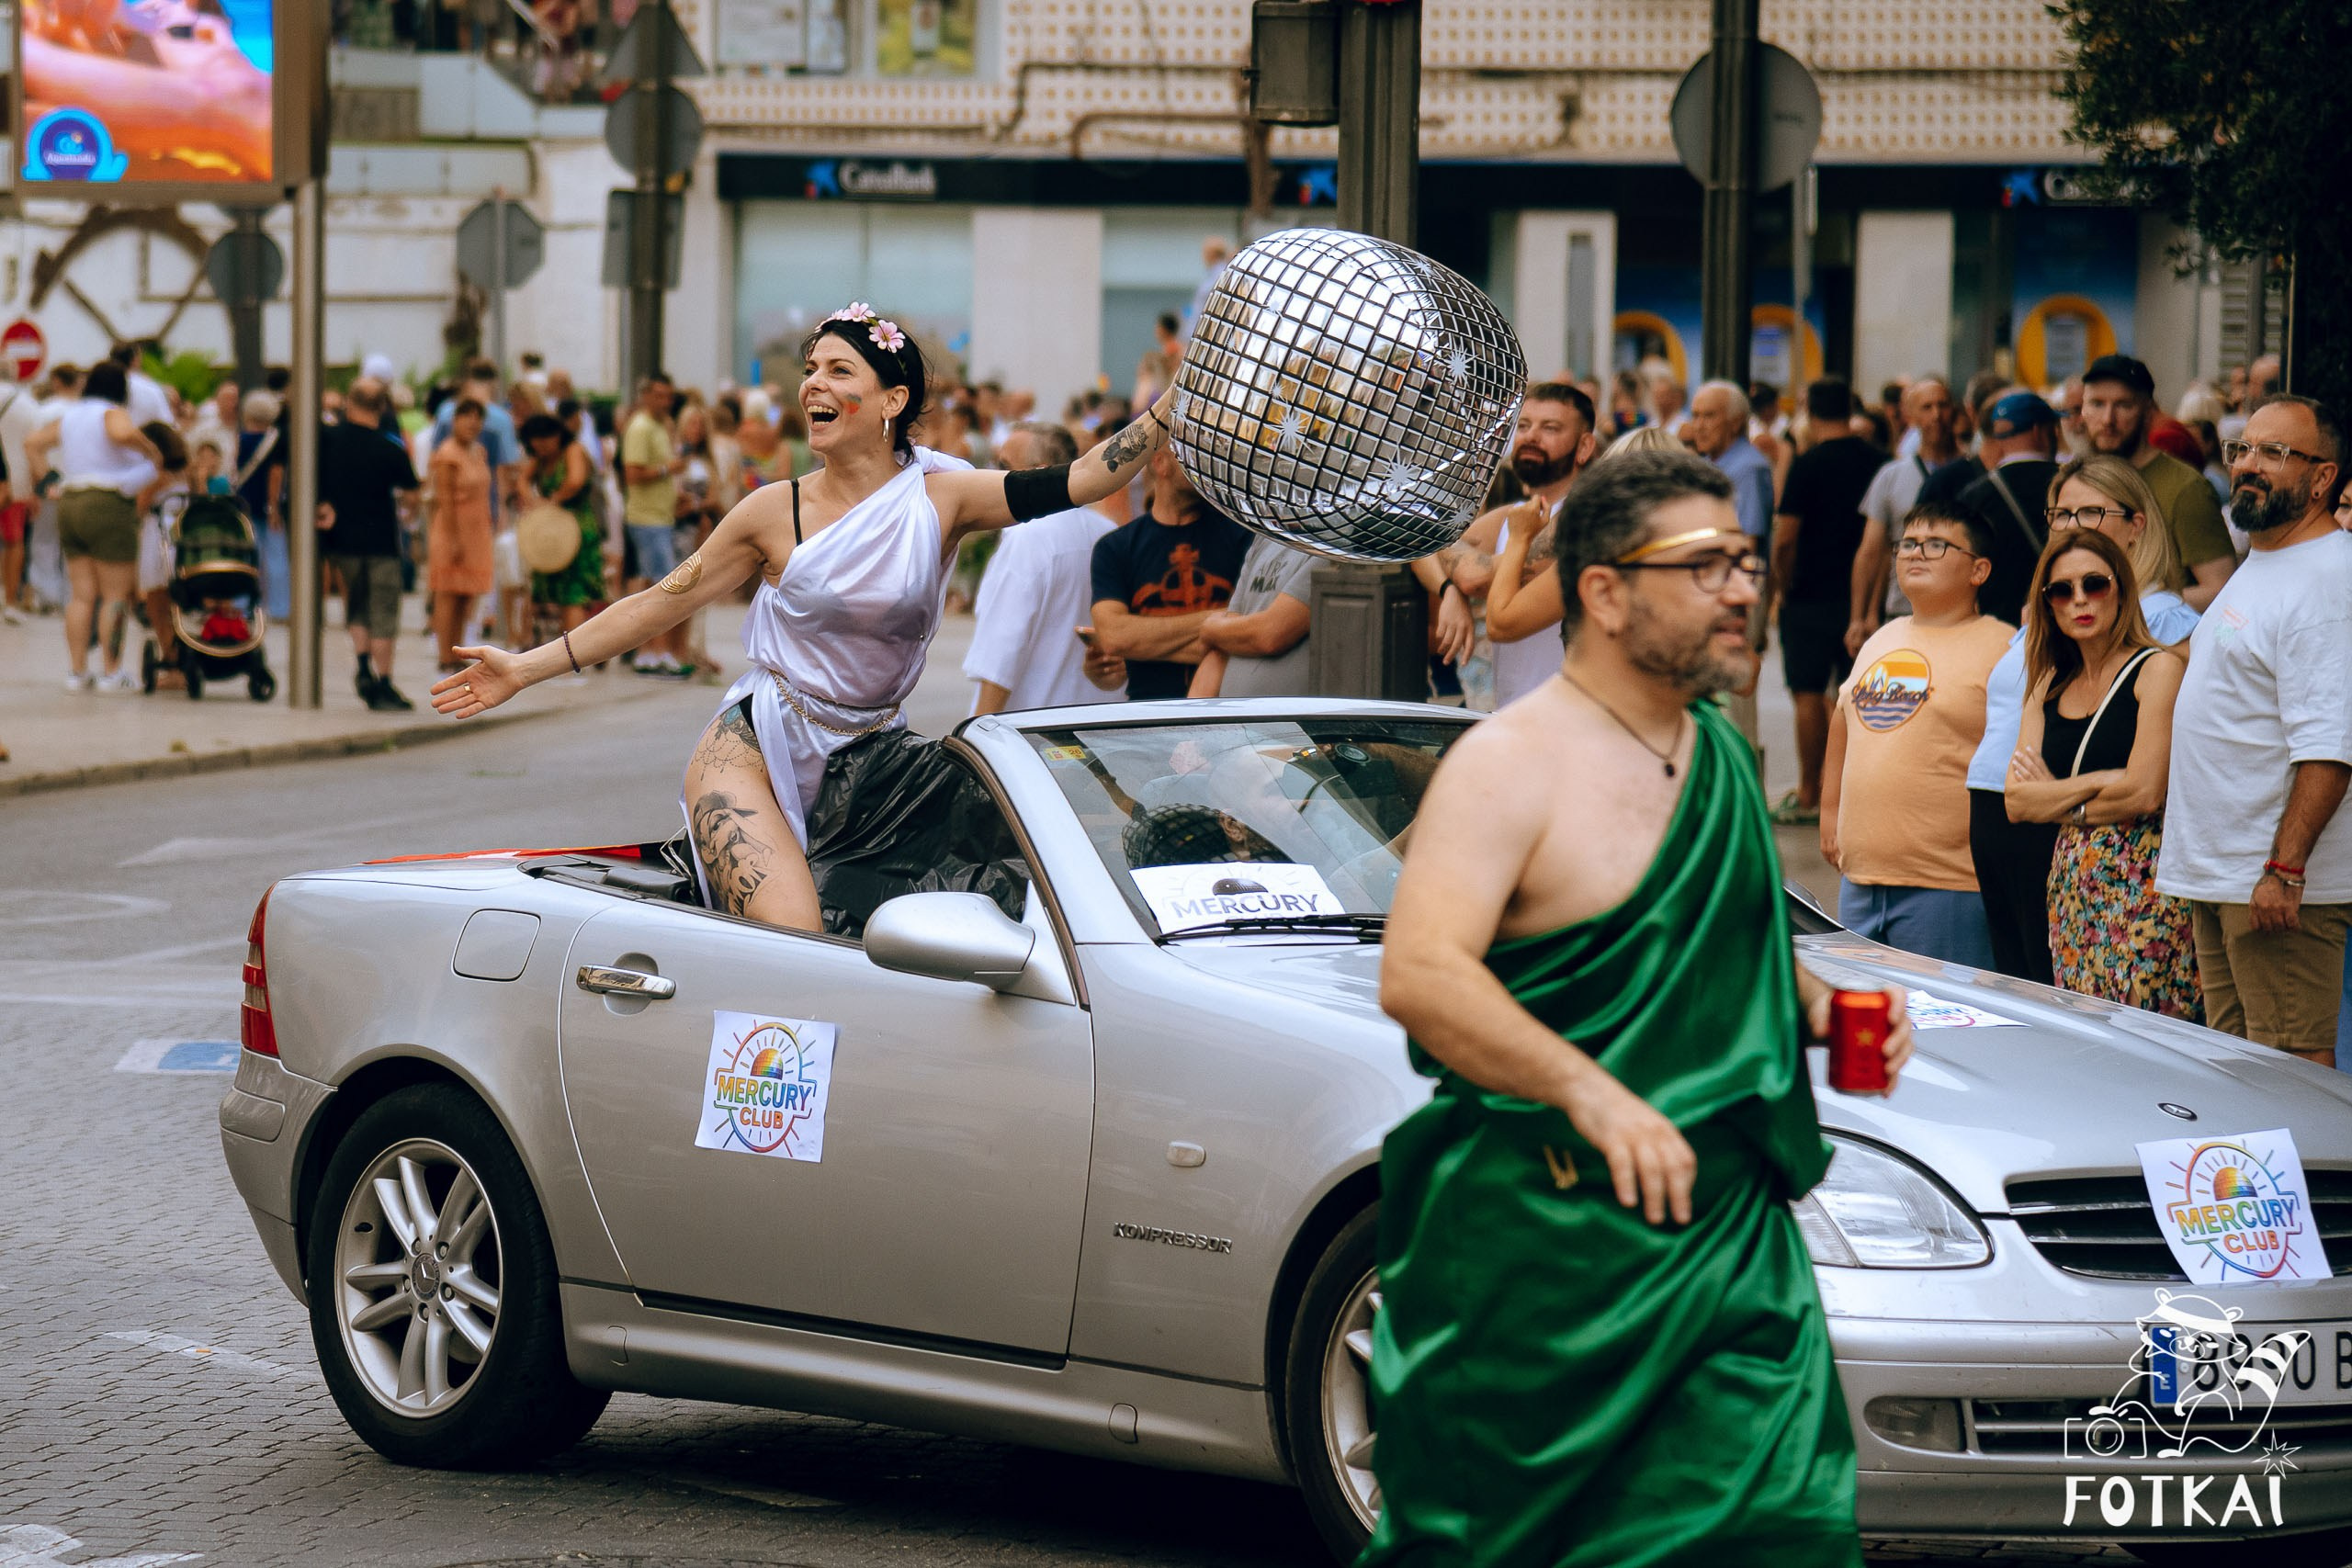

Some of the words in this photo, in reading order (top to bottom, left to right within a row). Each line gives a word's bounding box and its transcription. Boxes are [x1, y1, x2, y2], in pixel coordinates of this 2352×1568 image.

[1170, 894, 1318, 919] MERCURY
[717, 1075, 812, 1111] MERCURY
[740, 1106, 784, 1130] CLUB
[2175, 1198, 2295, 1237] MERCURY
[1113, 1222, 1233, 1255] KOMPRESSOR
[2223, 1230, 2280, 1254] CLUB
